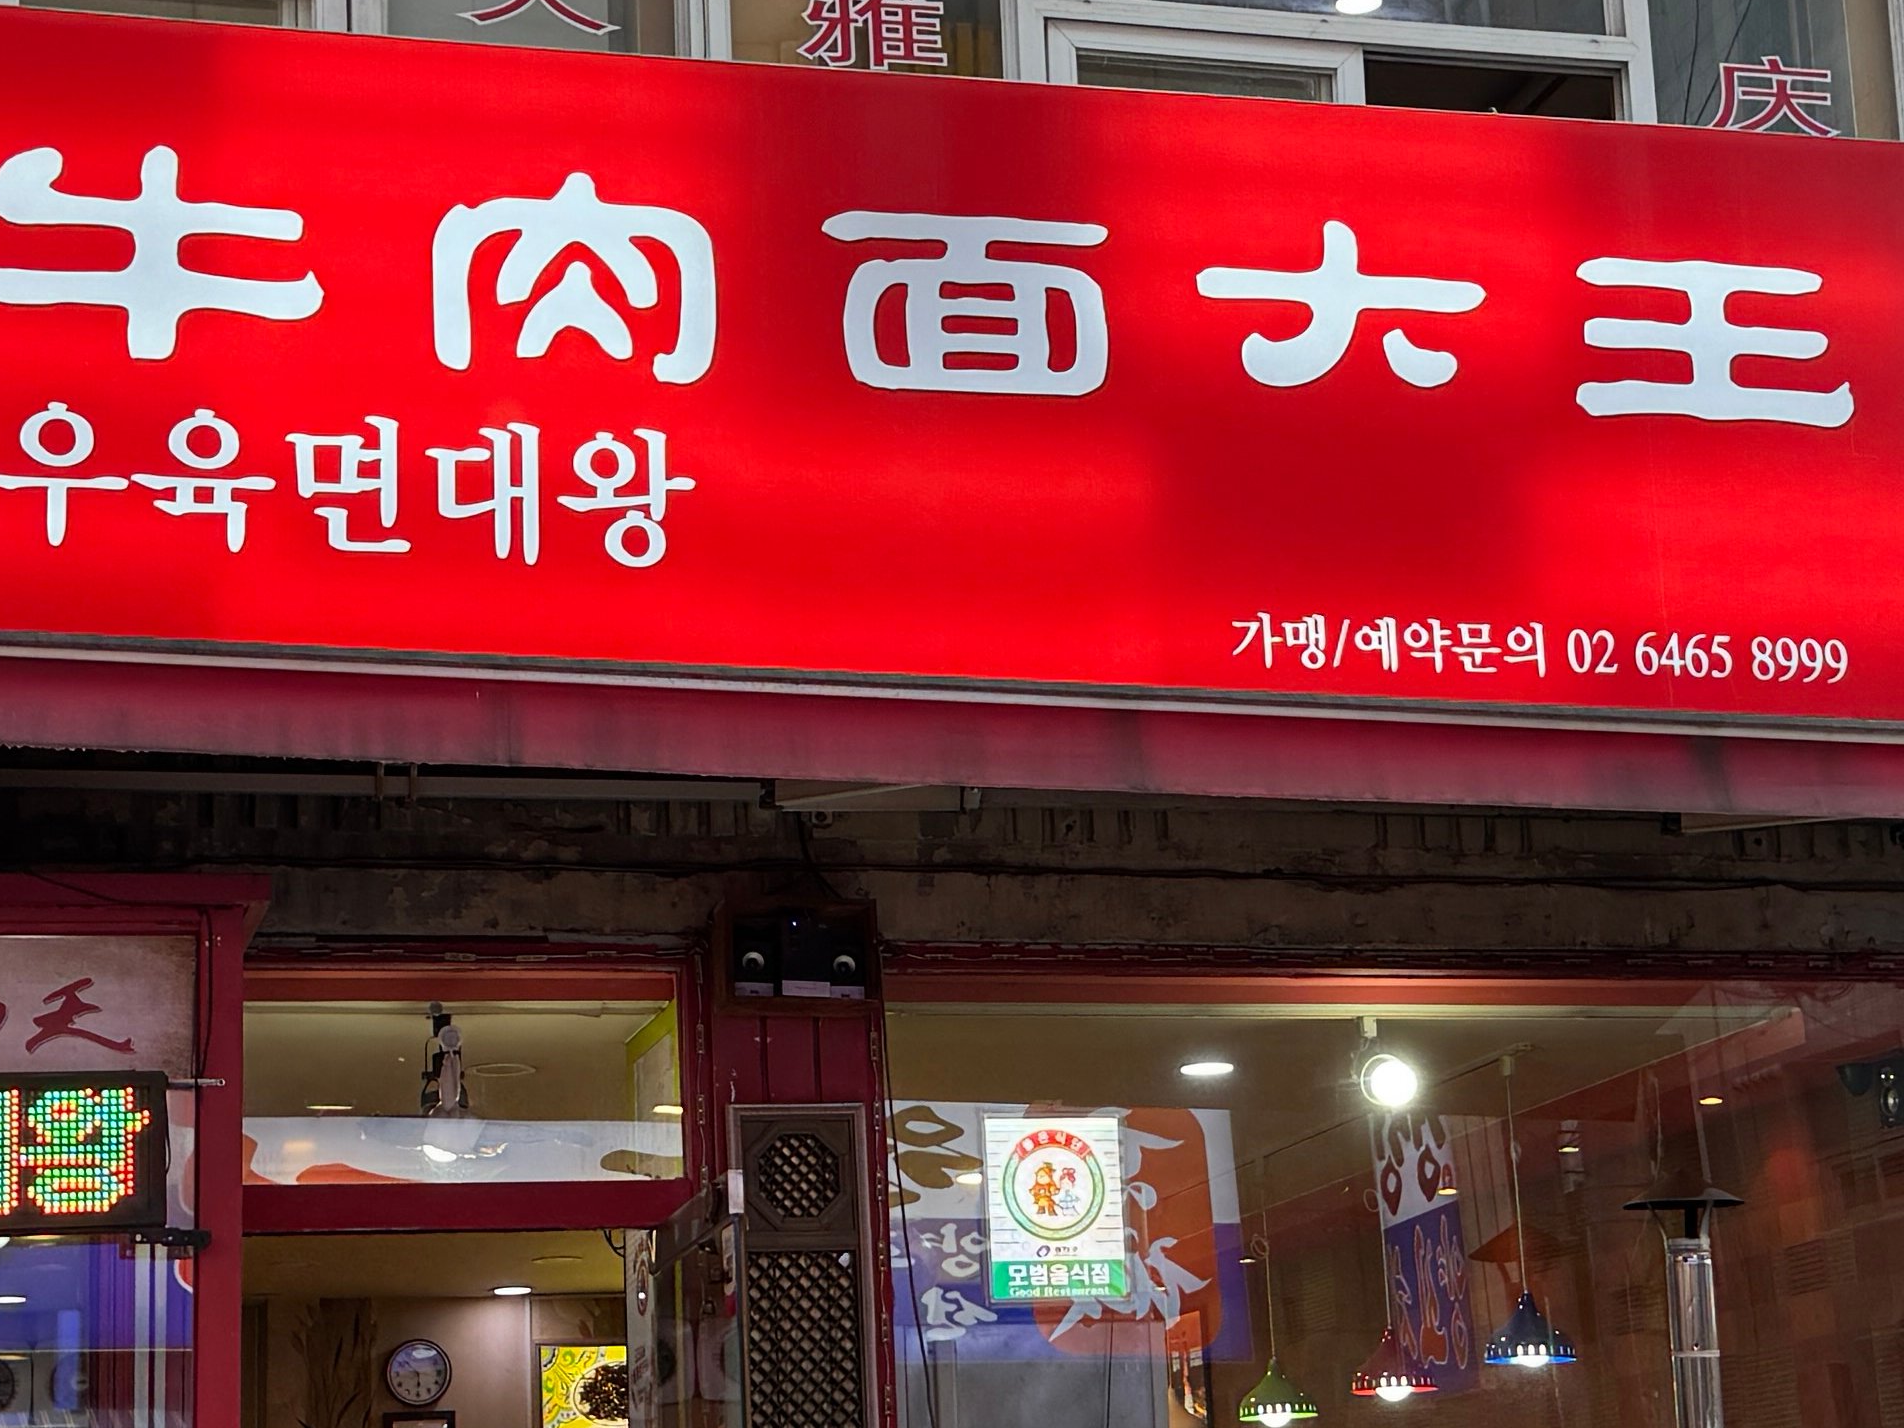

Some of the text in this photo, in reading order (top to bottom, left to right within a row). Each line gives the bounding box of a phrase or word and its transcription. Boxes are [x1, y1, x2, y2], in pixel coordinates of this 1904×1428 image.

[1230, 610, 1851, 687] 가맹/예약문의 02 6465 8999
[1007, 1262, 1110, 1287] 모범음식점
